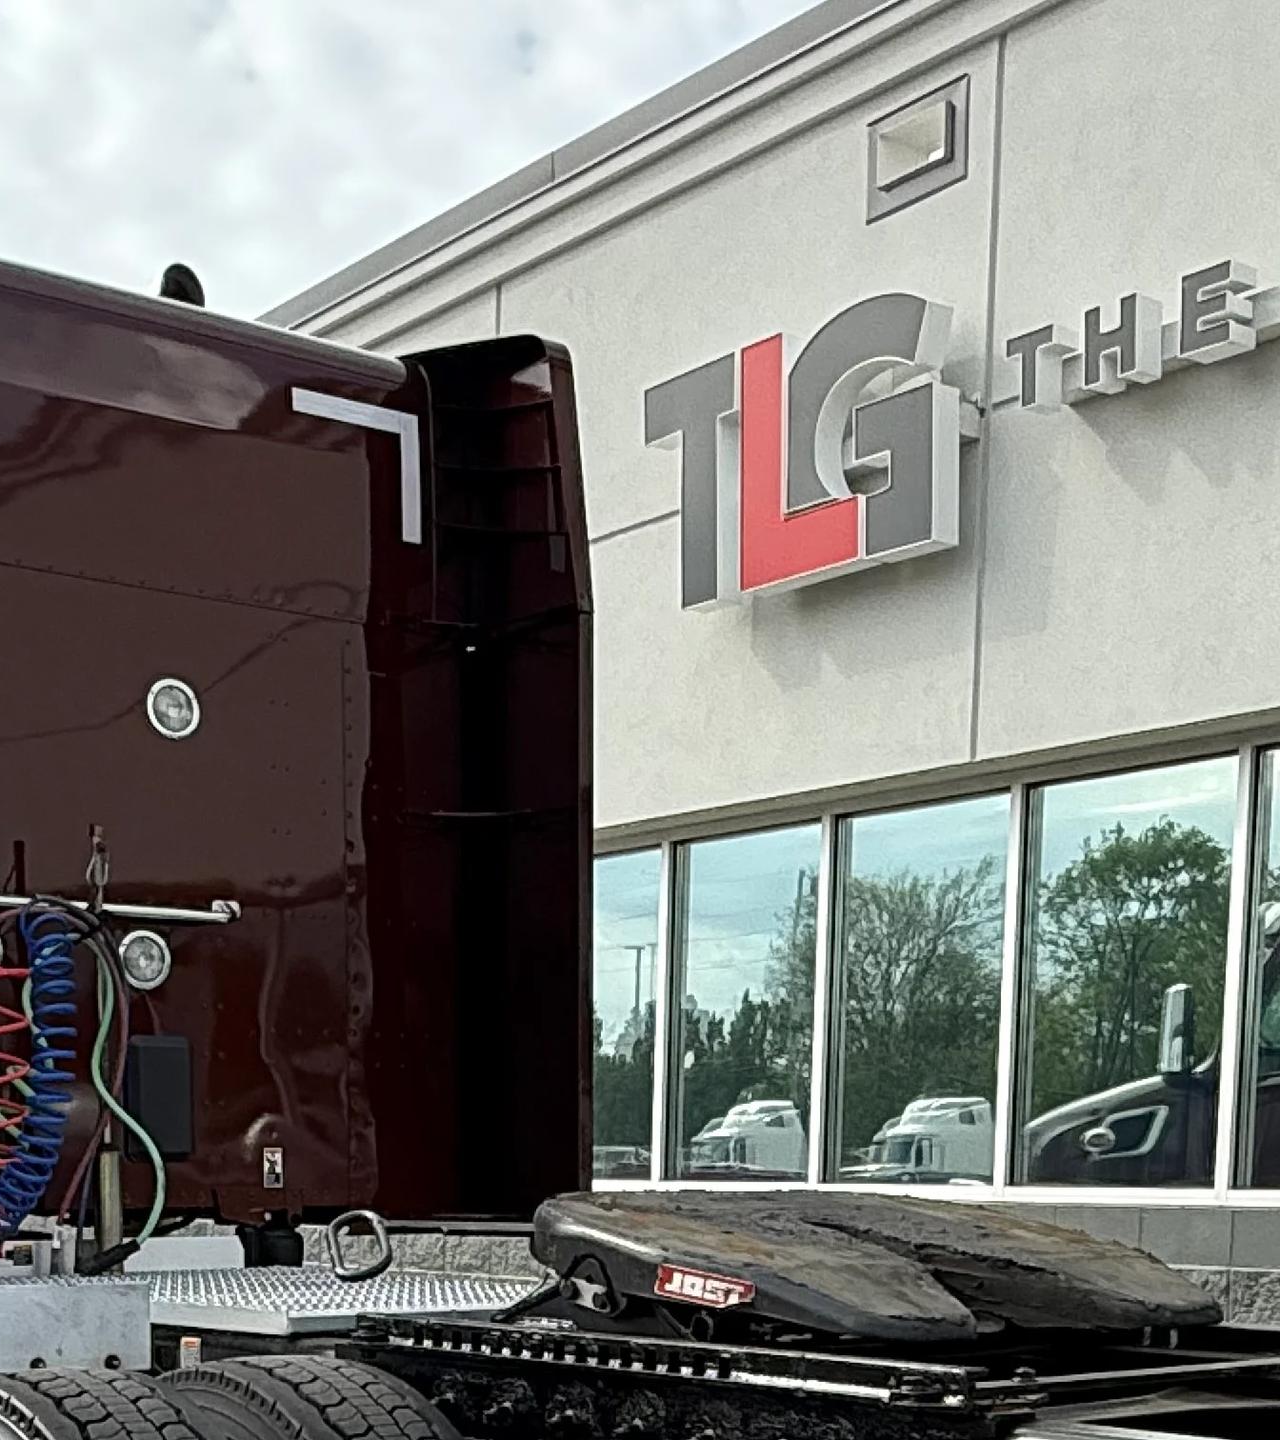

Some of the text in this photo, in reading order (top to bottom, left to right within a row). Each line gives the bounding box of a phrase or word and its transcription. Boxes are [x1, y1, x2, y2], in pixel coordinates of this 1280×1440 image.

[1006, 259, 1238, 407] THE
[644, 293, 945, 609] TLG
[663, 1271, 745, 1305] JOST
